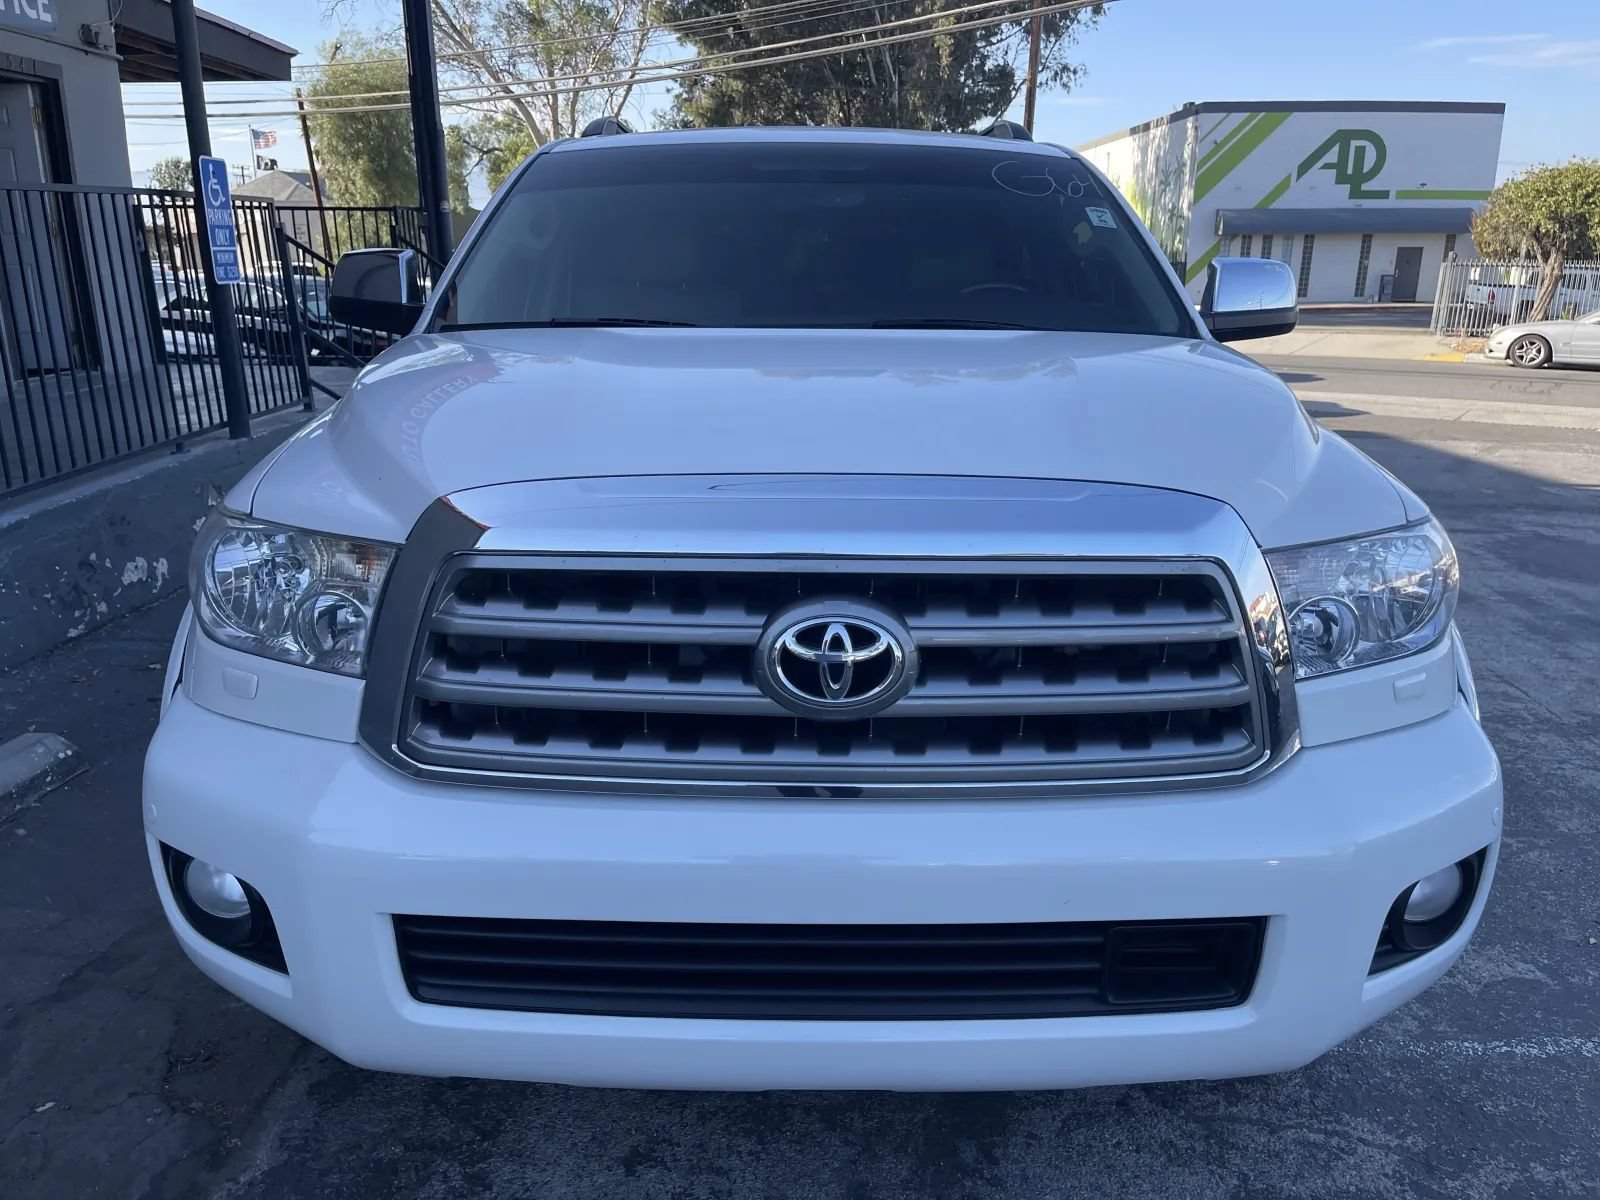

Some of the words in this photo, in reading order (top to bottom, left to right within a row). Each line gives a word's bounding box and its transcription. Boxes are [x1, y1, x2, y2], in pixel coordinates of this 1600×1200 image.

[1296, 129, 1390, 200] ADL
[208, 208, 233, 226] PARKING
[215, 228, 230, 245] ONLY
